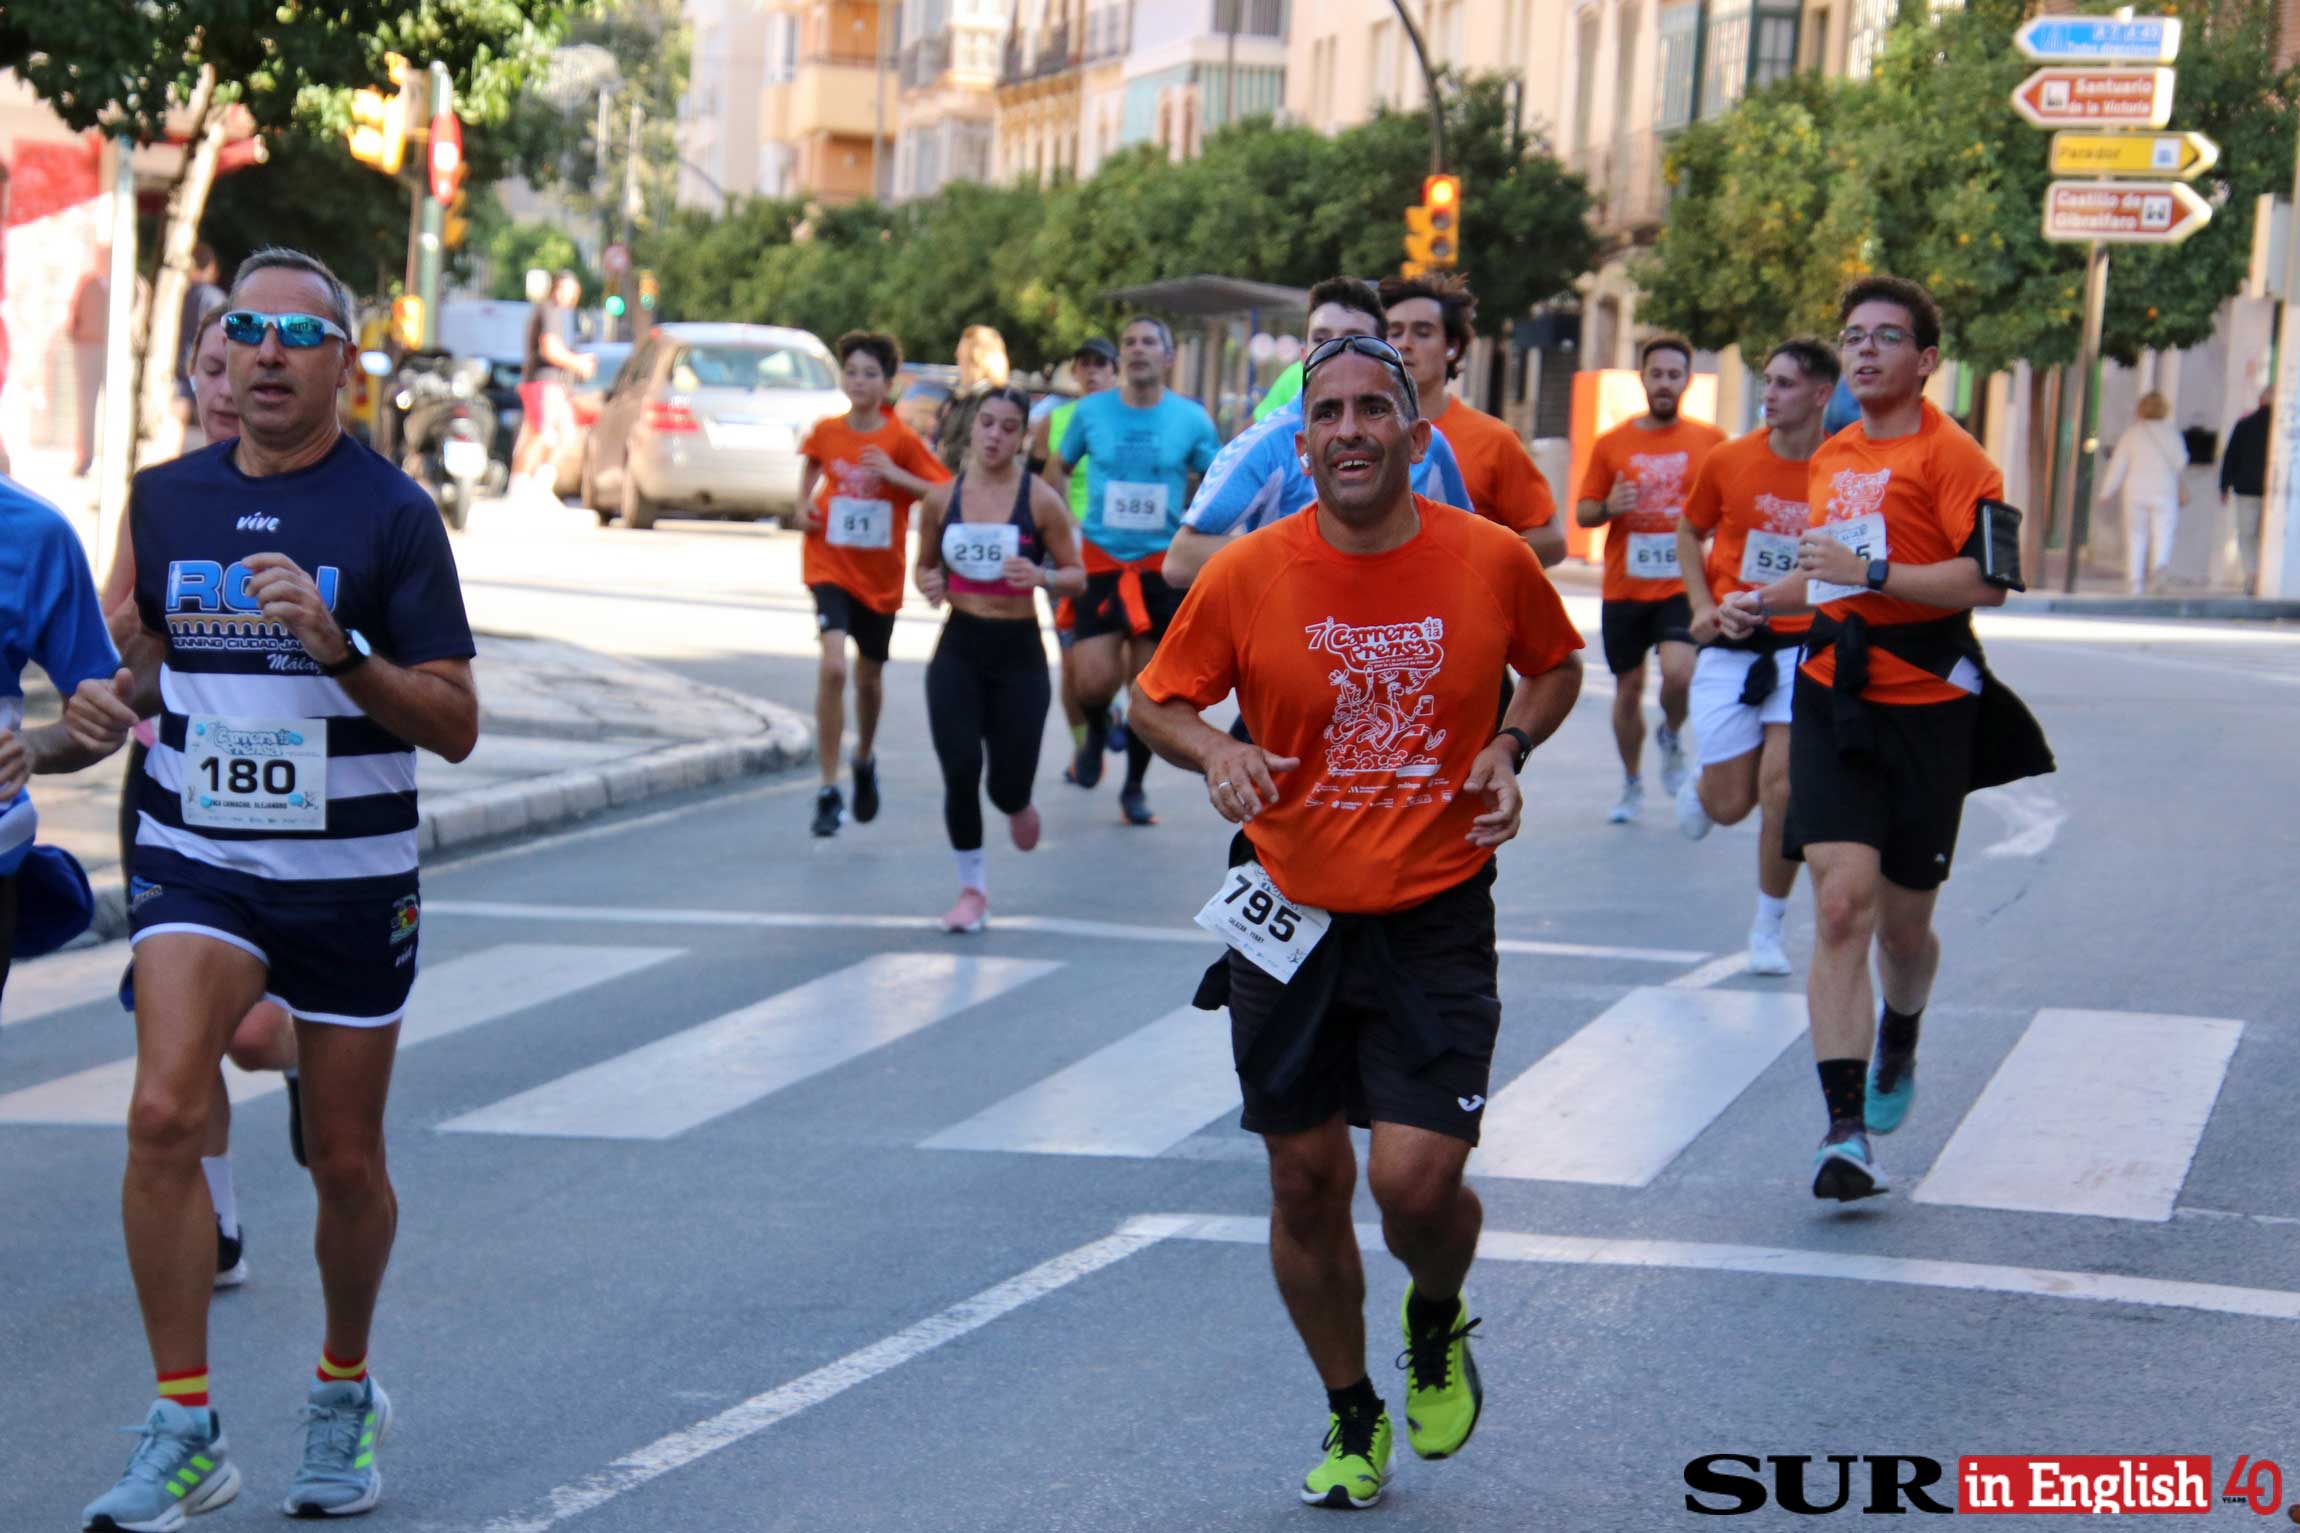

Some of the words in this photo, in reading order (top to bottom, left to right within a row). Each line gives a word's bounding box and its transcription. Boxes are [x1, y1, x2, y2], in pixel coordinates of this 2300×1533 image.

[2074, 77, 2152, 96] Santuario
[2103, 100, 2150, 115] Victoria
[2058, 145, 2121, 160] Parador
[2056, 191, 2118, 208] Castillo
[2121, 192, 2141, 208] de
[2056, 211, 2137, 229] Gibralfaro
[843, 515, 870, 533] 81
[953, 543, 1003, 563] 236
[226, 637, 280, 651] CIUDAD
[1328, 623, 1424, 650] Carrera
[200, 756, 296, 795] 180
[1224, 874, 1302, 943] 795
